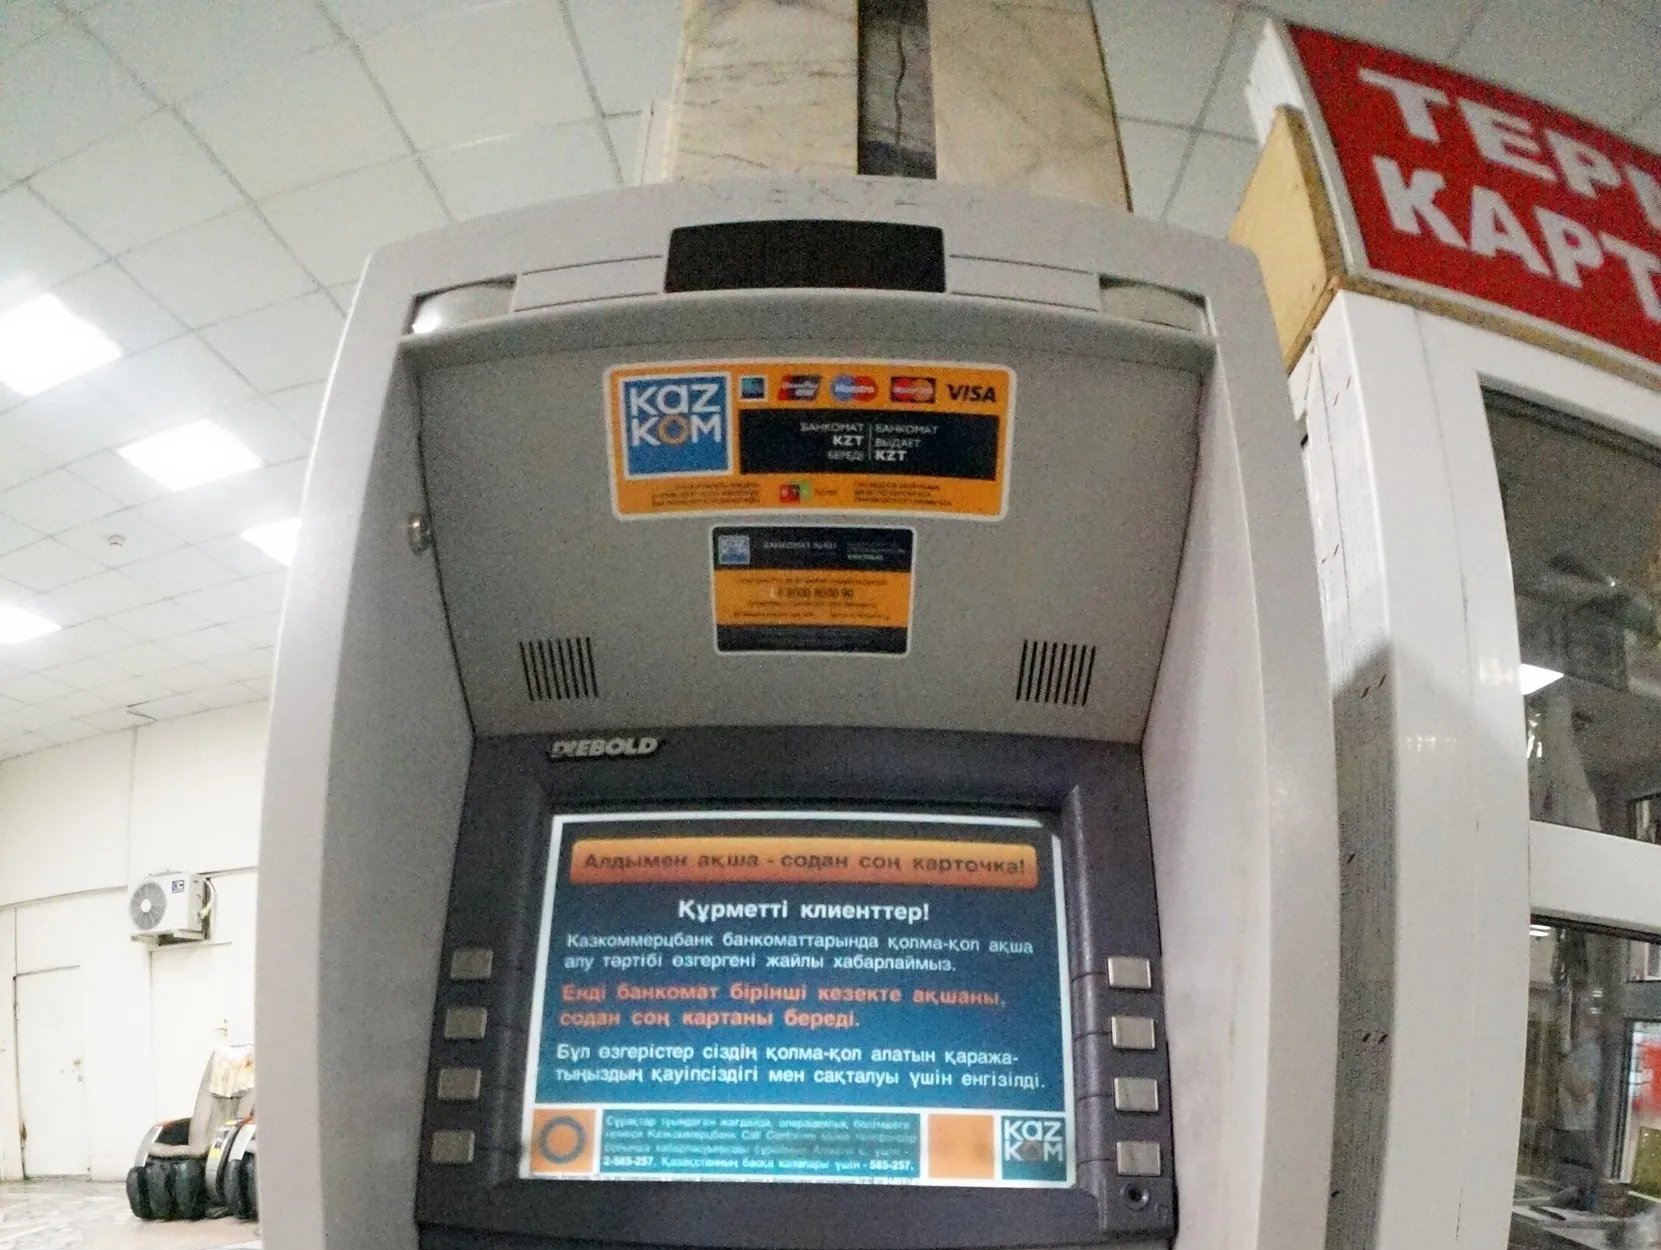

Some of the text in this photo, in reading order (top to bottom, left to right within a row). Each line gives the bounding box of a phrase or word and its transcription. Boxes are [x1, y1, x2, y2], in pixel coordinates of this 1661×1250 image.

[947, 384, 996, 402] VISA
[801, 423, 864, 432] БАНКОМАТ
[875, 424, 938, 434] БАНКОМАТ
[833, 435, 864, 446] KZT
[875, 451, 907, 461] KZT
[551, 737, 658, 758] DIEBOLD
[584, 854, 687, 870] Алдымен
[698, 854, 759, 870] ақша
[781, 854, 848, 871] содан
[858, 855, 900, 871] соң
[912, 856, 1025, 875] карточка!
[678, 899, 930, 924] Құрметті клиенттер!
[567, 932, 713, 949] Казкоммерцбанк
[722, 931, 878, 950] банкоматтарында
[988, 940, 1034, 955] ақша
[603, 953, 662, 972] тәртібі
[672, 953, 755, 972] өзгергені
[766, 953, 824, 968] жайлы
[832, 953, 956, 972] хабарлаймыз.
[562, 983, 607, 1002] Енді
[617, 982, 719, 1000] банкомат
[730, 982, 807, 1003] бірінші
[818, 986, 902, 1002] кезекте
[560, 1008, 860, 1030] содан соң картаны береді.
[557, 1043, 590, 1062] Бұл
[599, 1043, 694, 1062] өзгерістер
[703, 1043, 758, 1062] сіздің
[766, 1046, 861, 1064] қолма-қол
[871, 1049, 936, 1062] алатын
[556, 1066, 1046, 1089] тыңыздың қауіпсіздігі мен сақталуы үшін енгізілді.
